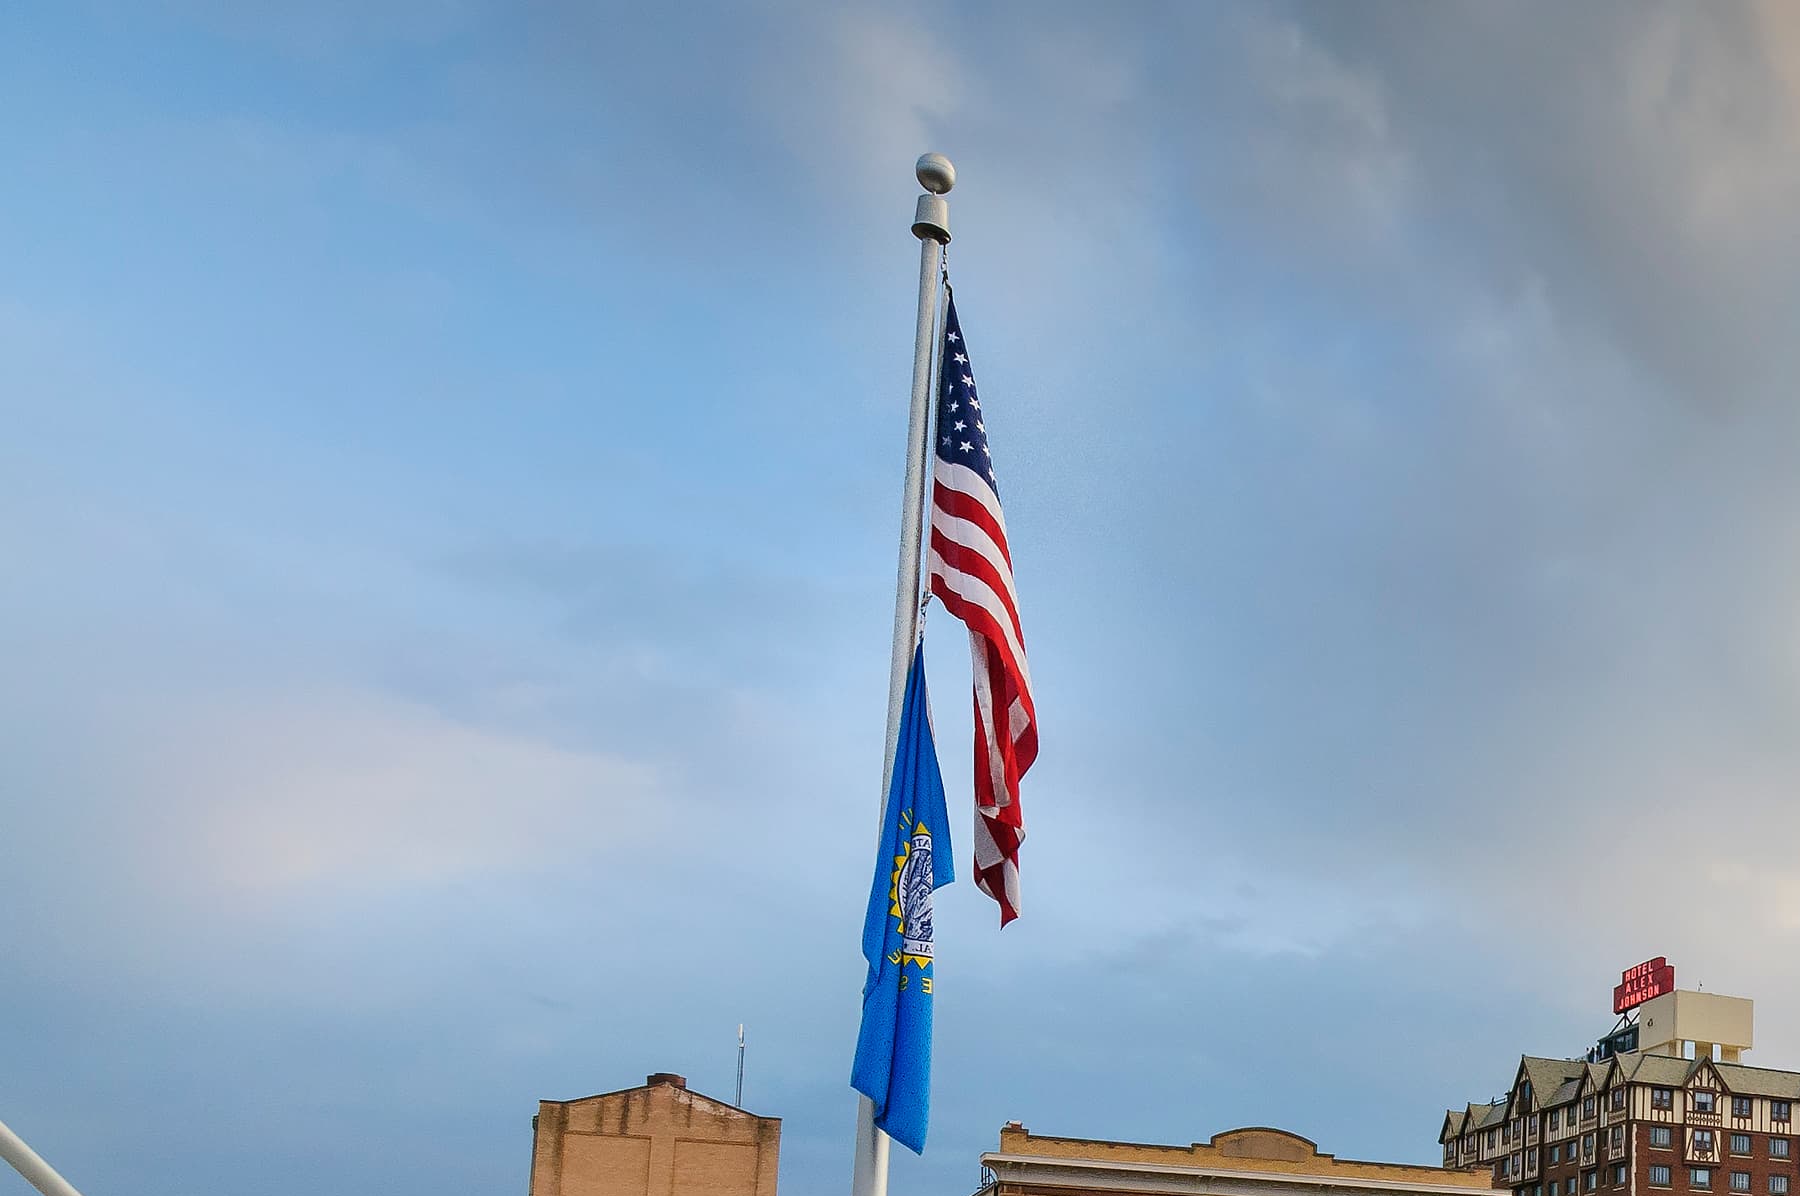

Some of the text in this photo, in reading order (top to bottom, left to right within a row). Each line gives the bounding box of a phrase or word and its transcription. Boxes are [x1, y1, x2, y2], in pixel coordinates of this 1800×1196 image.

[1625, 962, 1653, 981] HOTEL
[1625, 973, 1653, 993] ALEX
[1619, 984, 1659, 1010] JOHNSON
